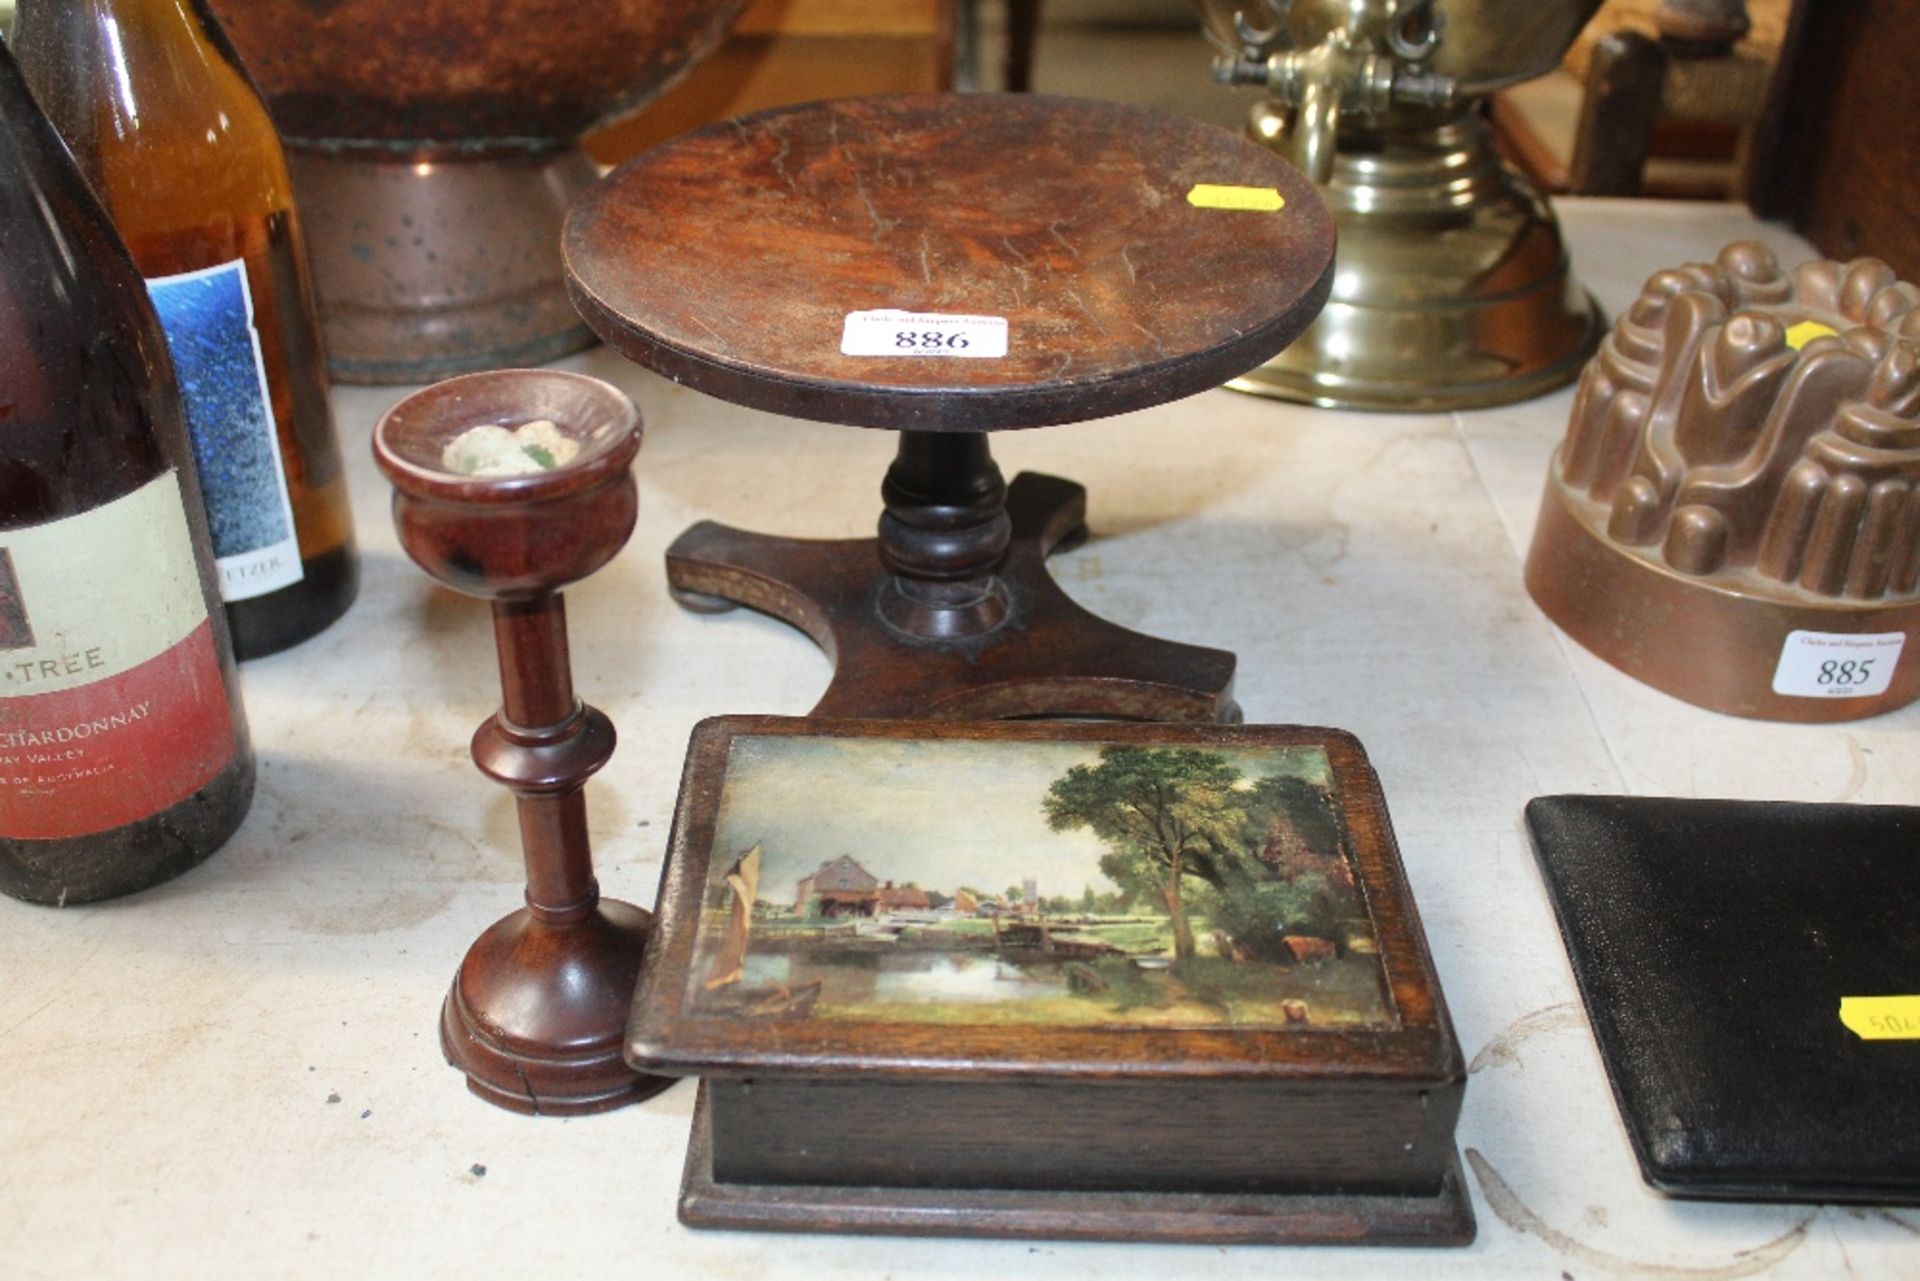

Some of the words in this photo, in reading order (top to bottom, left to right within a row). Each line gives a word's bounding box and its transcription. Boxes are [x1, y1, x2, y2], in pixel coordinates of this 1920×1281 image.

[895, 331, 970, 349] 886
[1817, 659, 1876, 685] 885
[26, 749, 85, 763] VALLEY
